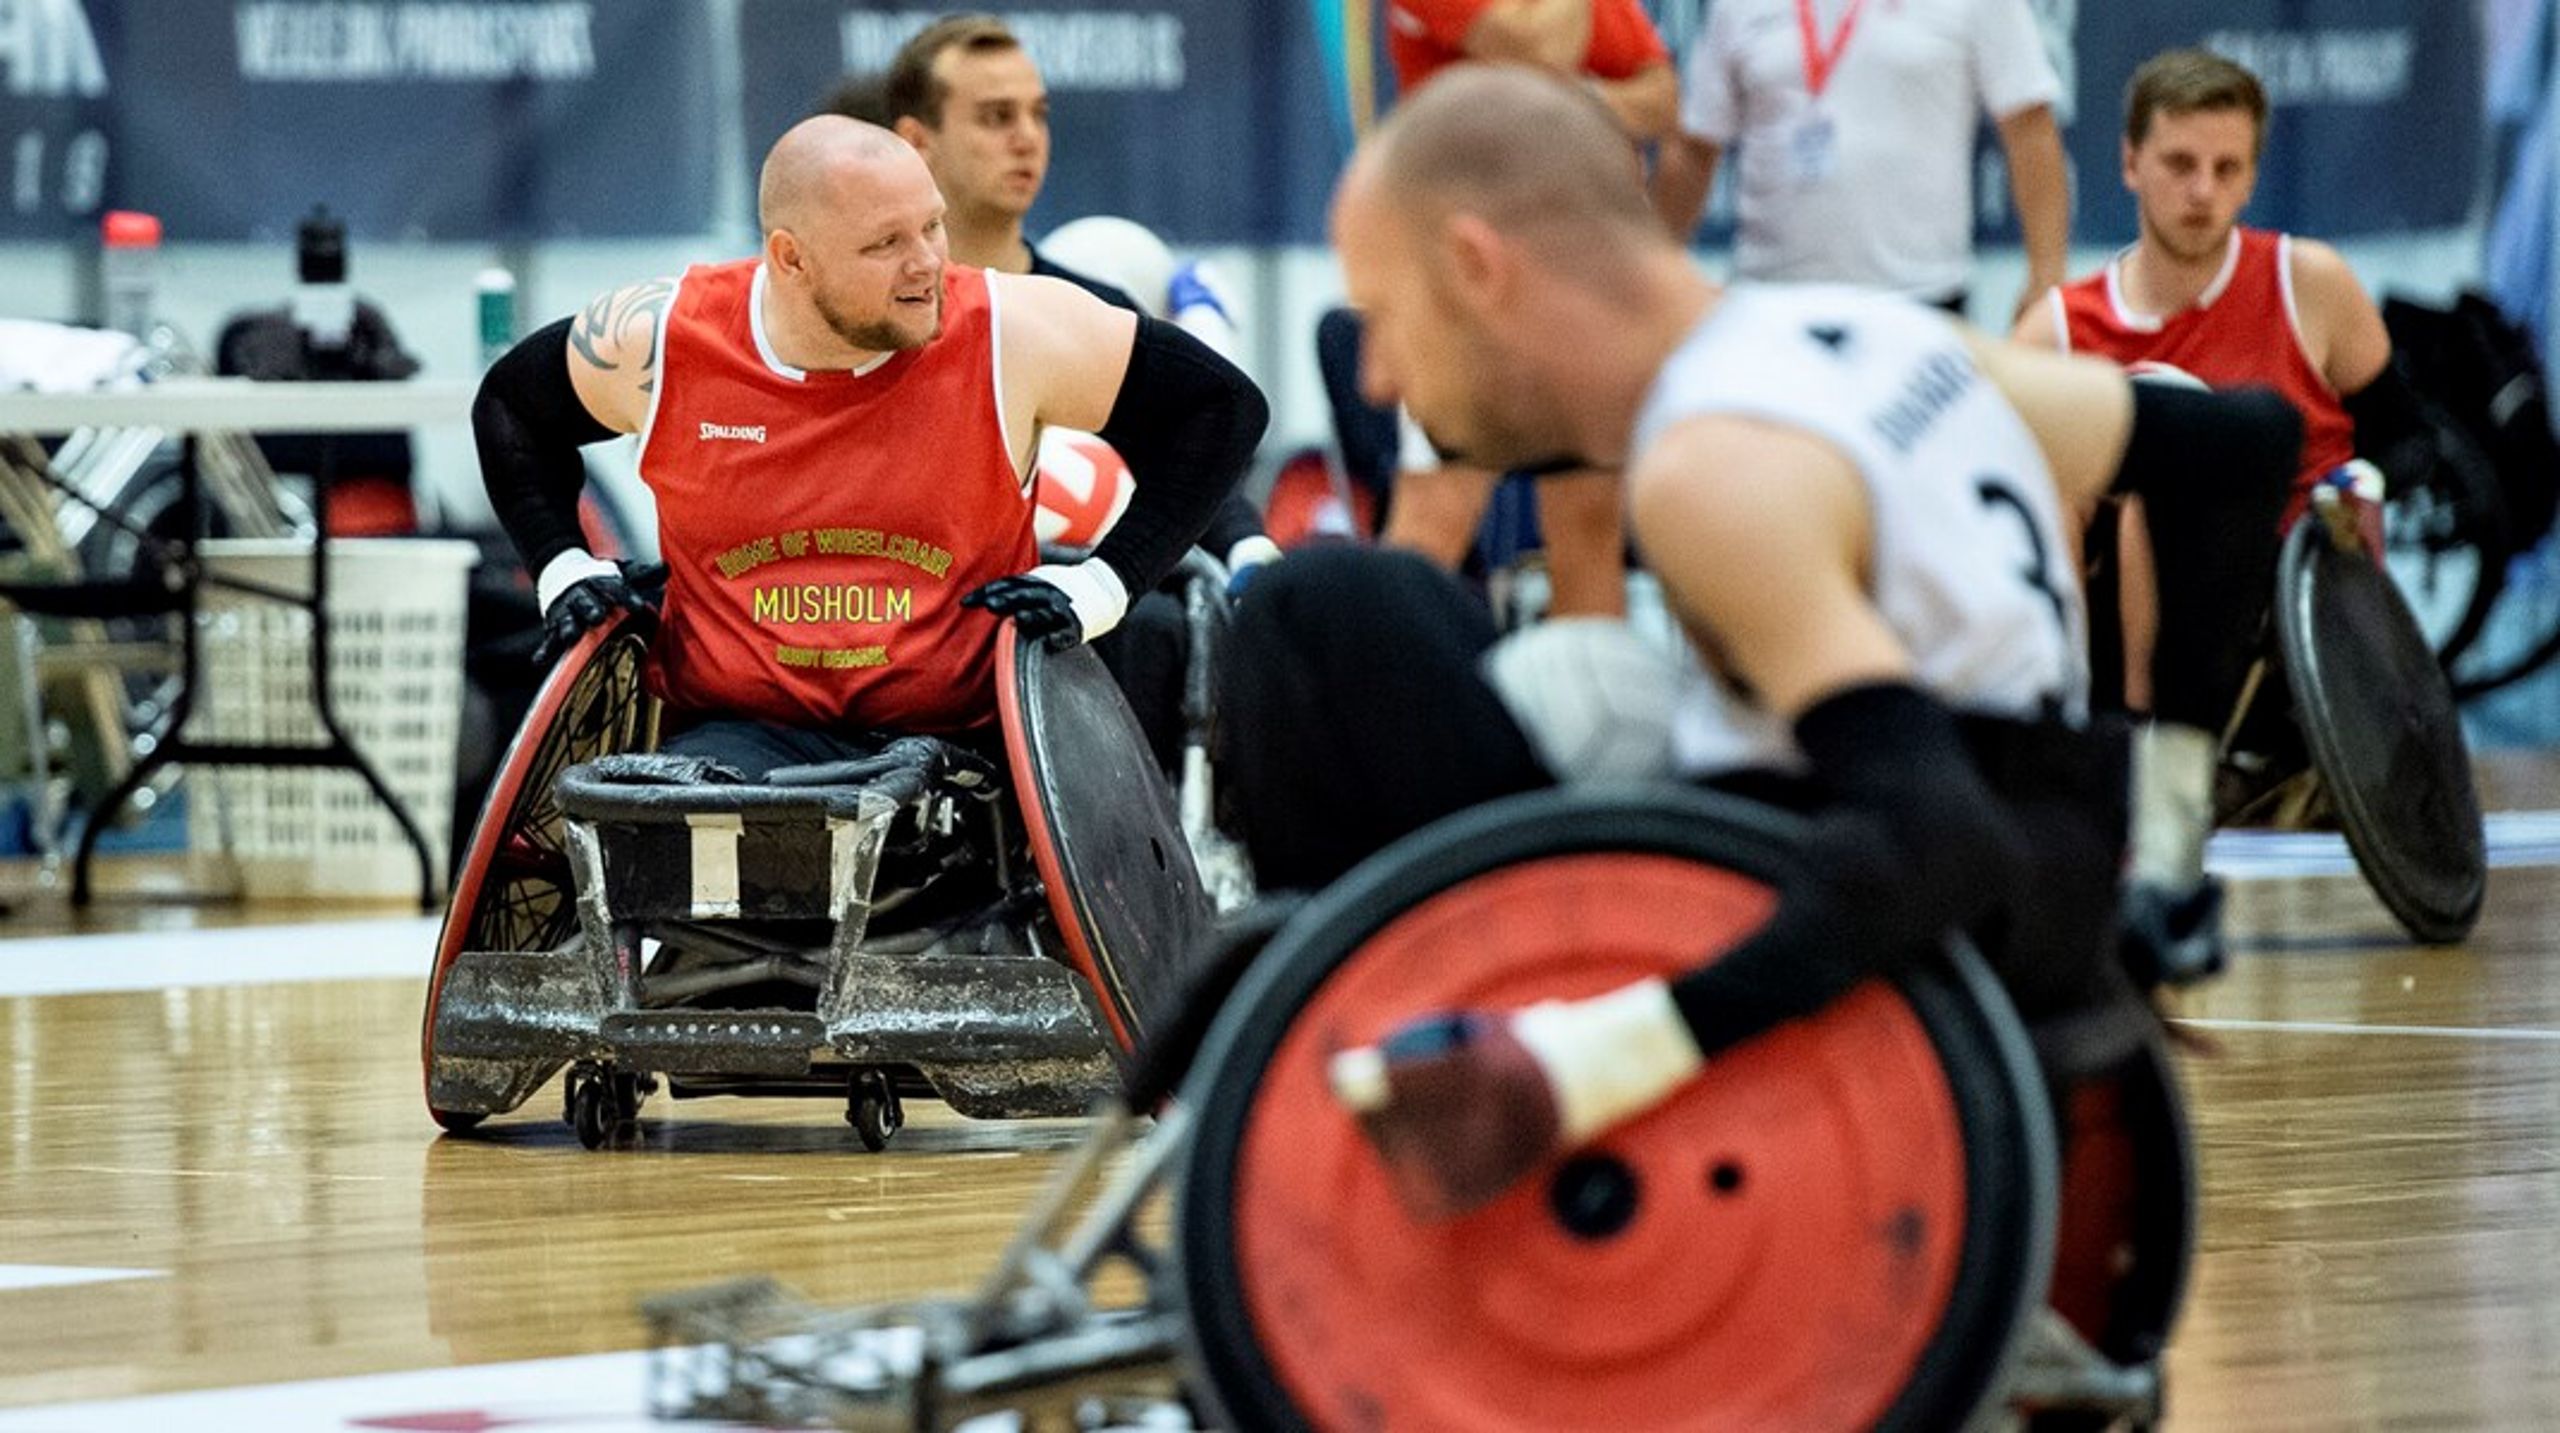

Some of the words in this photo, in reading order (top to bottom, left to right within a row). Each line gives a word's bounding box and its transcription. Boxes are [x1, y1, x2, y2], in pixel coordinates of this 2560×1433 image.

[699, 422, 767, 443] SPALDING
[781, 530, 811, 557] OF
[754, 585, 911, 623] MUSHOLM
